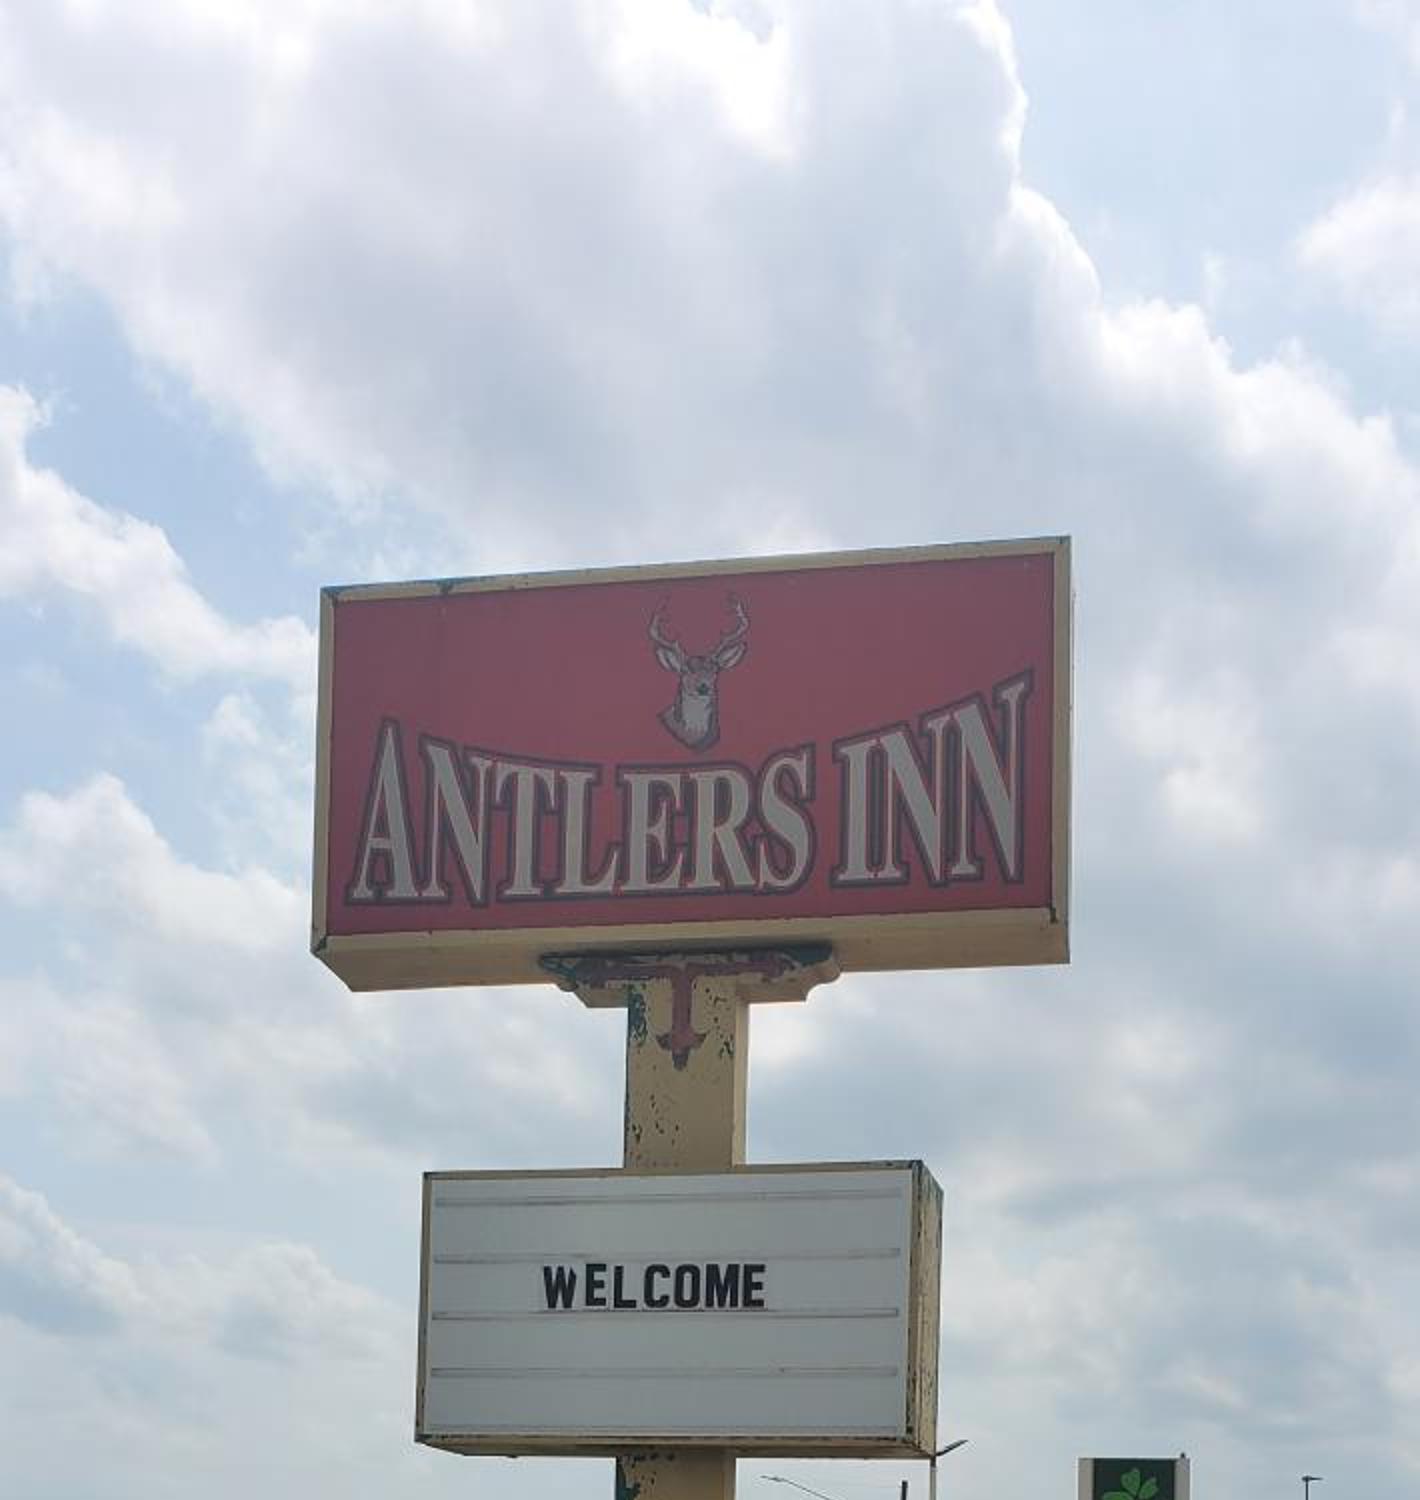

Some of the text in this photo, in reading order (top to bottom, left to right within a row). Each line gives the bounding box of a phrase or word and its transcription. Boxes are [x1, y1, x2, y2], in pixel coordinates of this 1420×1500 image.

[349, 671, 1034, 907] ANTLERS INN
[543, 1263, 766, 1309] WELCOME
